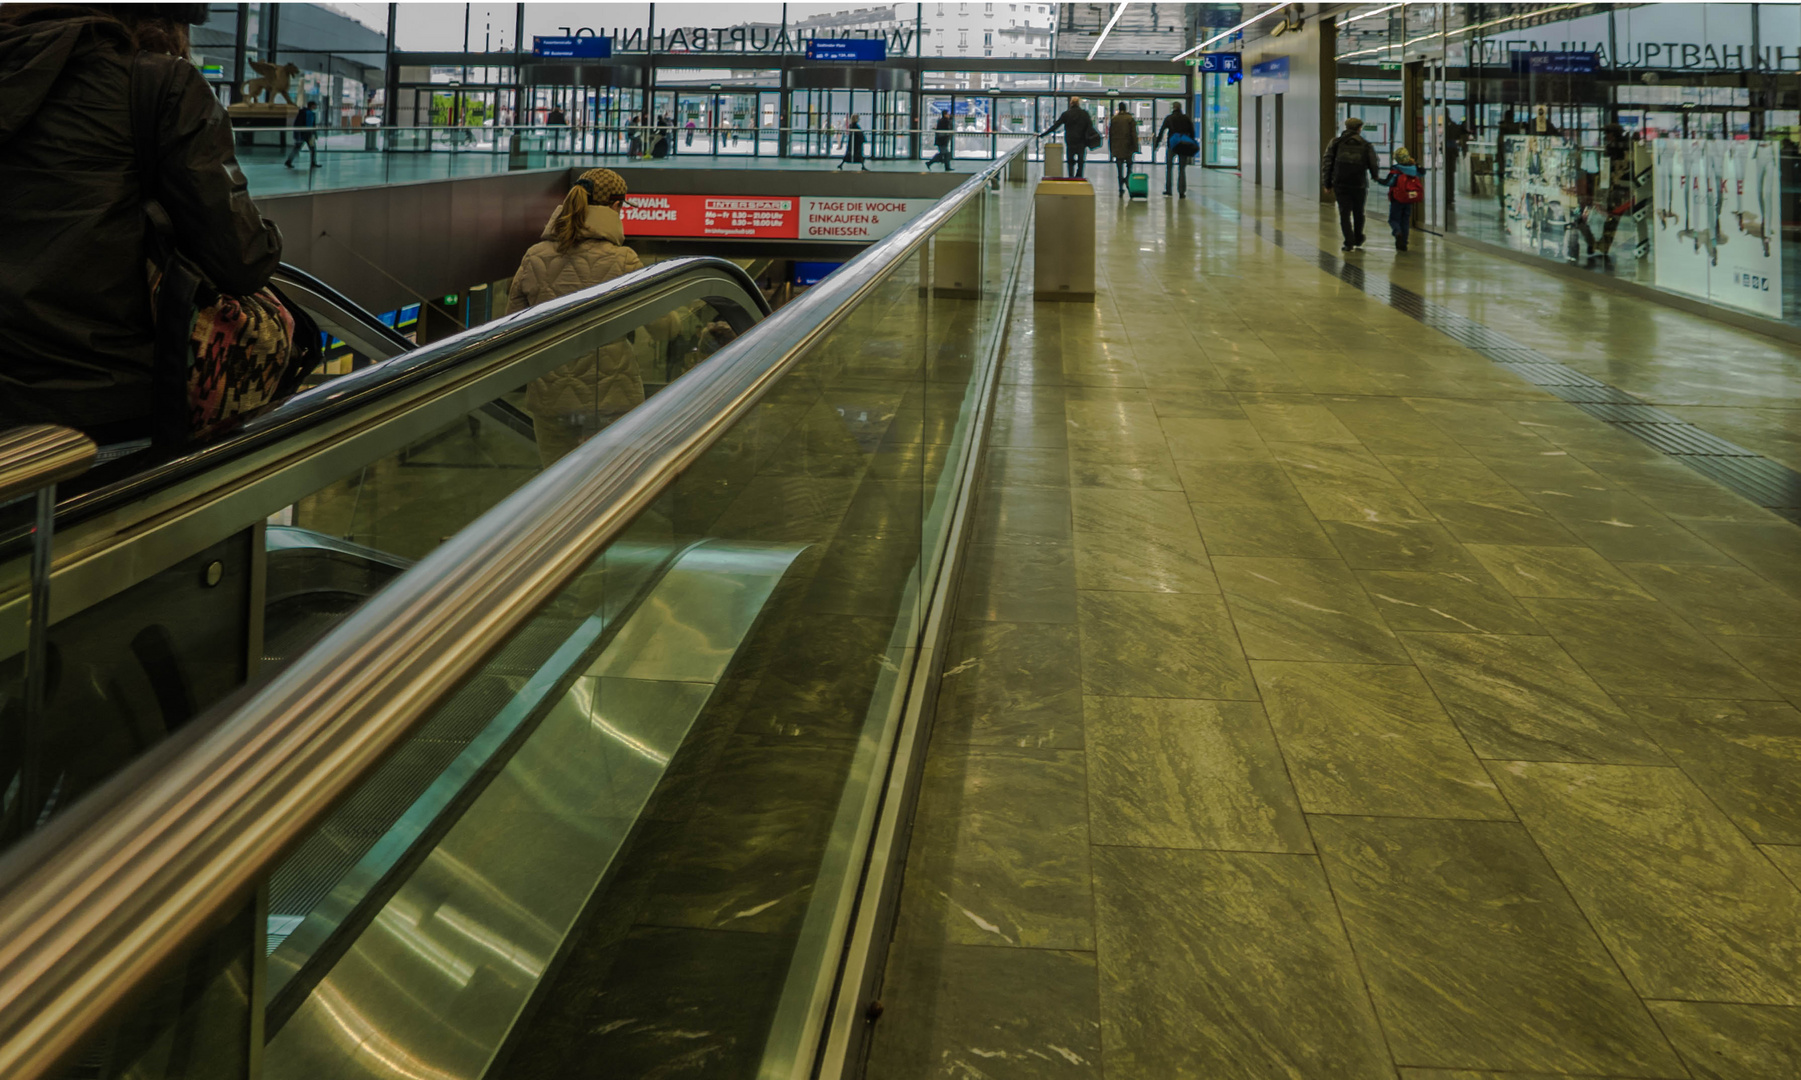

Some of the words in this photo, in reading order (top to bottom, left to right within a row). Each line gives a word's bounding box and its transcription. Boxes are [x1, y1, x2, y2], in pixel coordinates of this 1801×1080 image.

[1681, 175, 1744, 195] FALKE
[712, 201, 781, 209] INTERSPAR
[810, 202, 816, 211] 7
[818, 202, 845, 211] TAGE
[847, 203, 863, 212] DIE
[866, 203, 907, 213] WOCHE
[626, 207, 677, 221] TÄGLICHE
[809, 214, 869, 224] EINKAUFEN
[871, 215, 879, 224] &
[809, 226, 870, 236] GENIESSEN.
